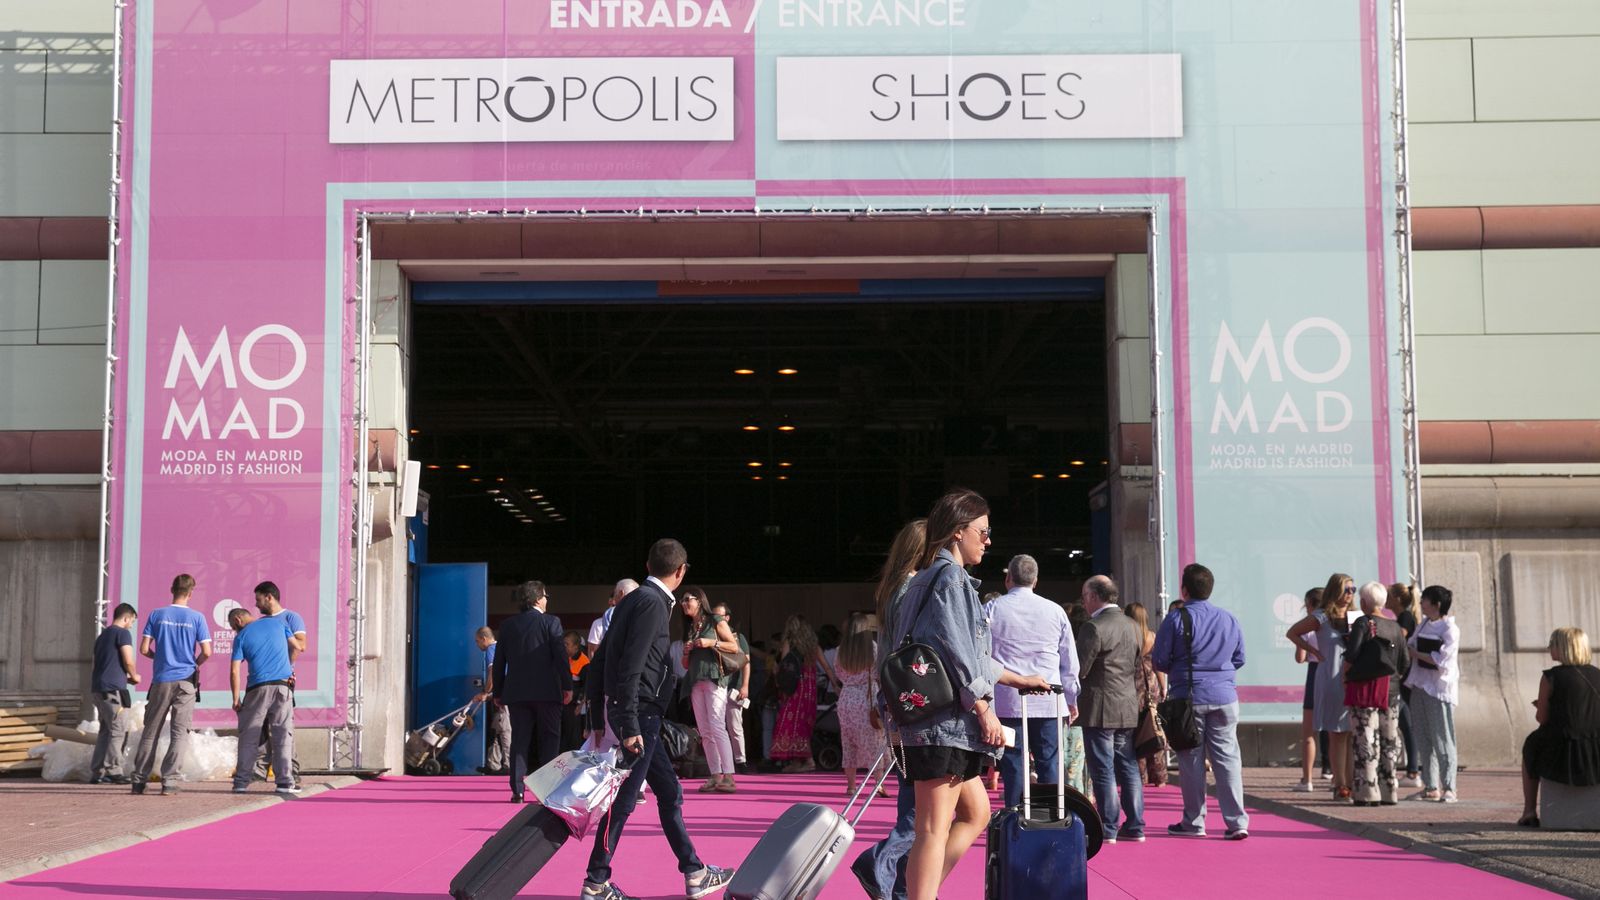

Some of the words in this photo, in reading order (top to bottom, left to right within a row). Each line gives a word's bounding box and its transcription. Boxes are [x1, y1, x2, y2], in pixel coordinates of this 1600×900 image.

[549, 0, 732, 28] ENTRADA
[778, 0, 966, 27] ENTRANCE
[346, 75, 718, 124] METROPOLIS
[869, 72, 1086, 122] SHOES
[163, 323, 308, 391] MO
[1209, 316, 1352, 384] MO
[161, 397, 306, 441] MAD
[1209, 390, 1353, 435] MAD
[161, 450, 207, 462] MODA
[216, 450, 236, 462] EN
[245, 450, 303, 462] MADRID
[1209, 457, 1266, 470] MADRID
[1271, 457, 1284, 469] IS
[1288, 456, 1353, 469] FASHION
[1210, 443, 1257, 456] MODA
[1265, 443, 1285, 455] EN
[1295, 443, 1353, 455] MADRID
[160, 463, 217, 475] MADRID
[221, 463, 234, 475] IS
[238, 463, 302, 475] FASHION
[213, 631, 235, 640] IFEM
